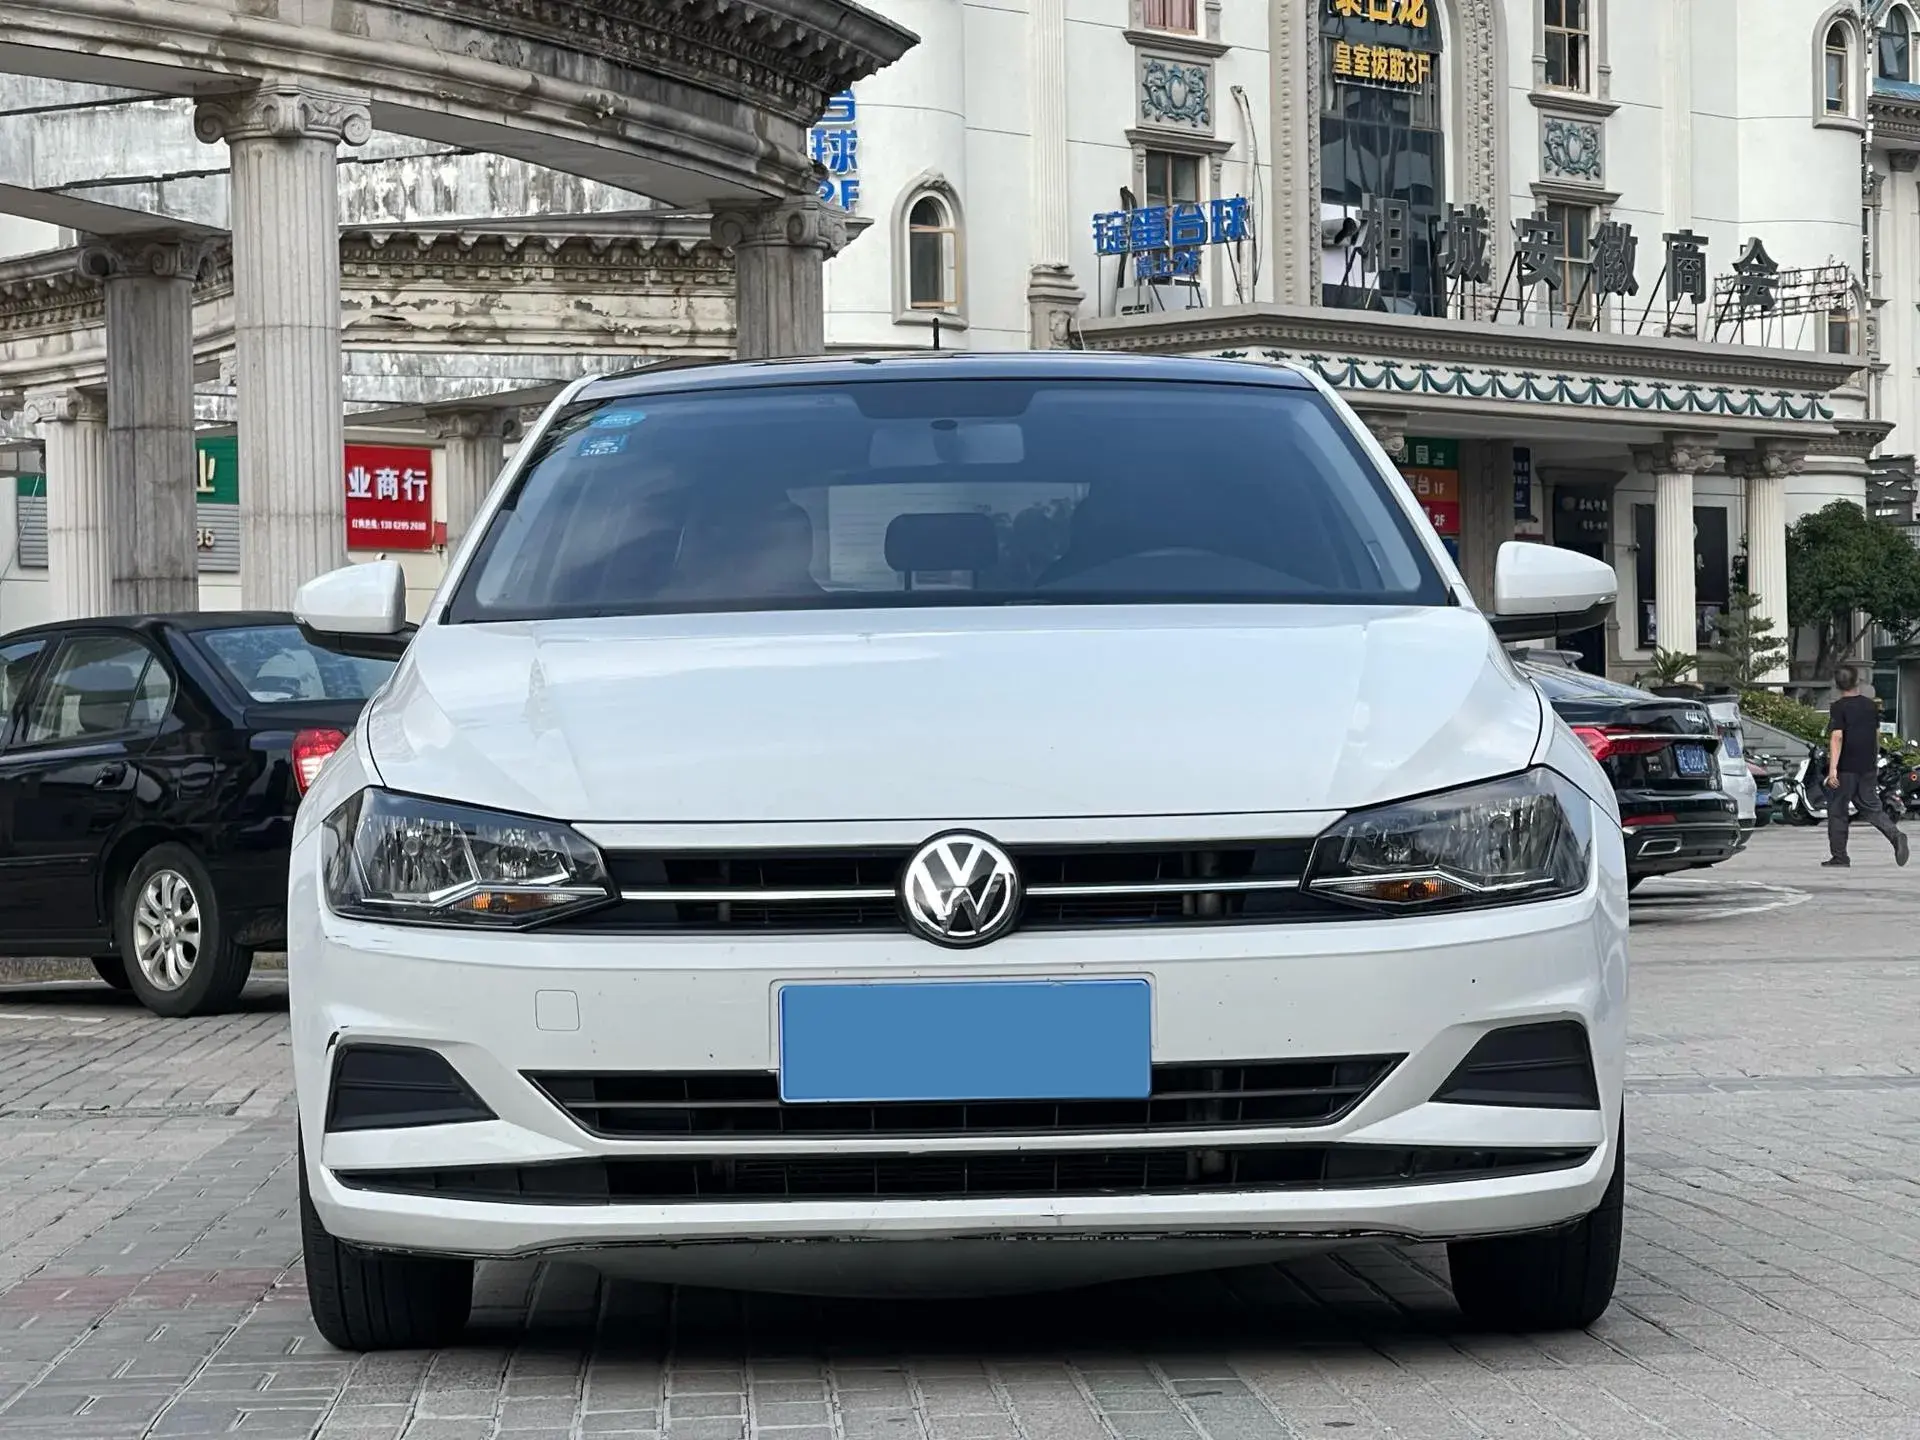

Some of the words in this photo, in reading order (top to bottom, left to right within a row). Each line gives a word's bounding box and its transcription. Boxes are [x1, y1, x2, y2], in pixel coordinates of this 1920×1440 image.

[1355, 192, 1780, 312] 相城安徽商会
[347, 465, 428, 502] 业商行
